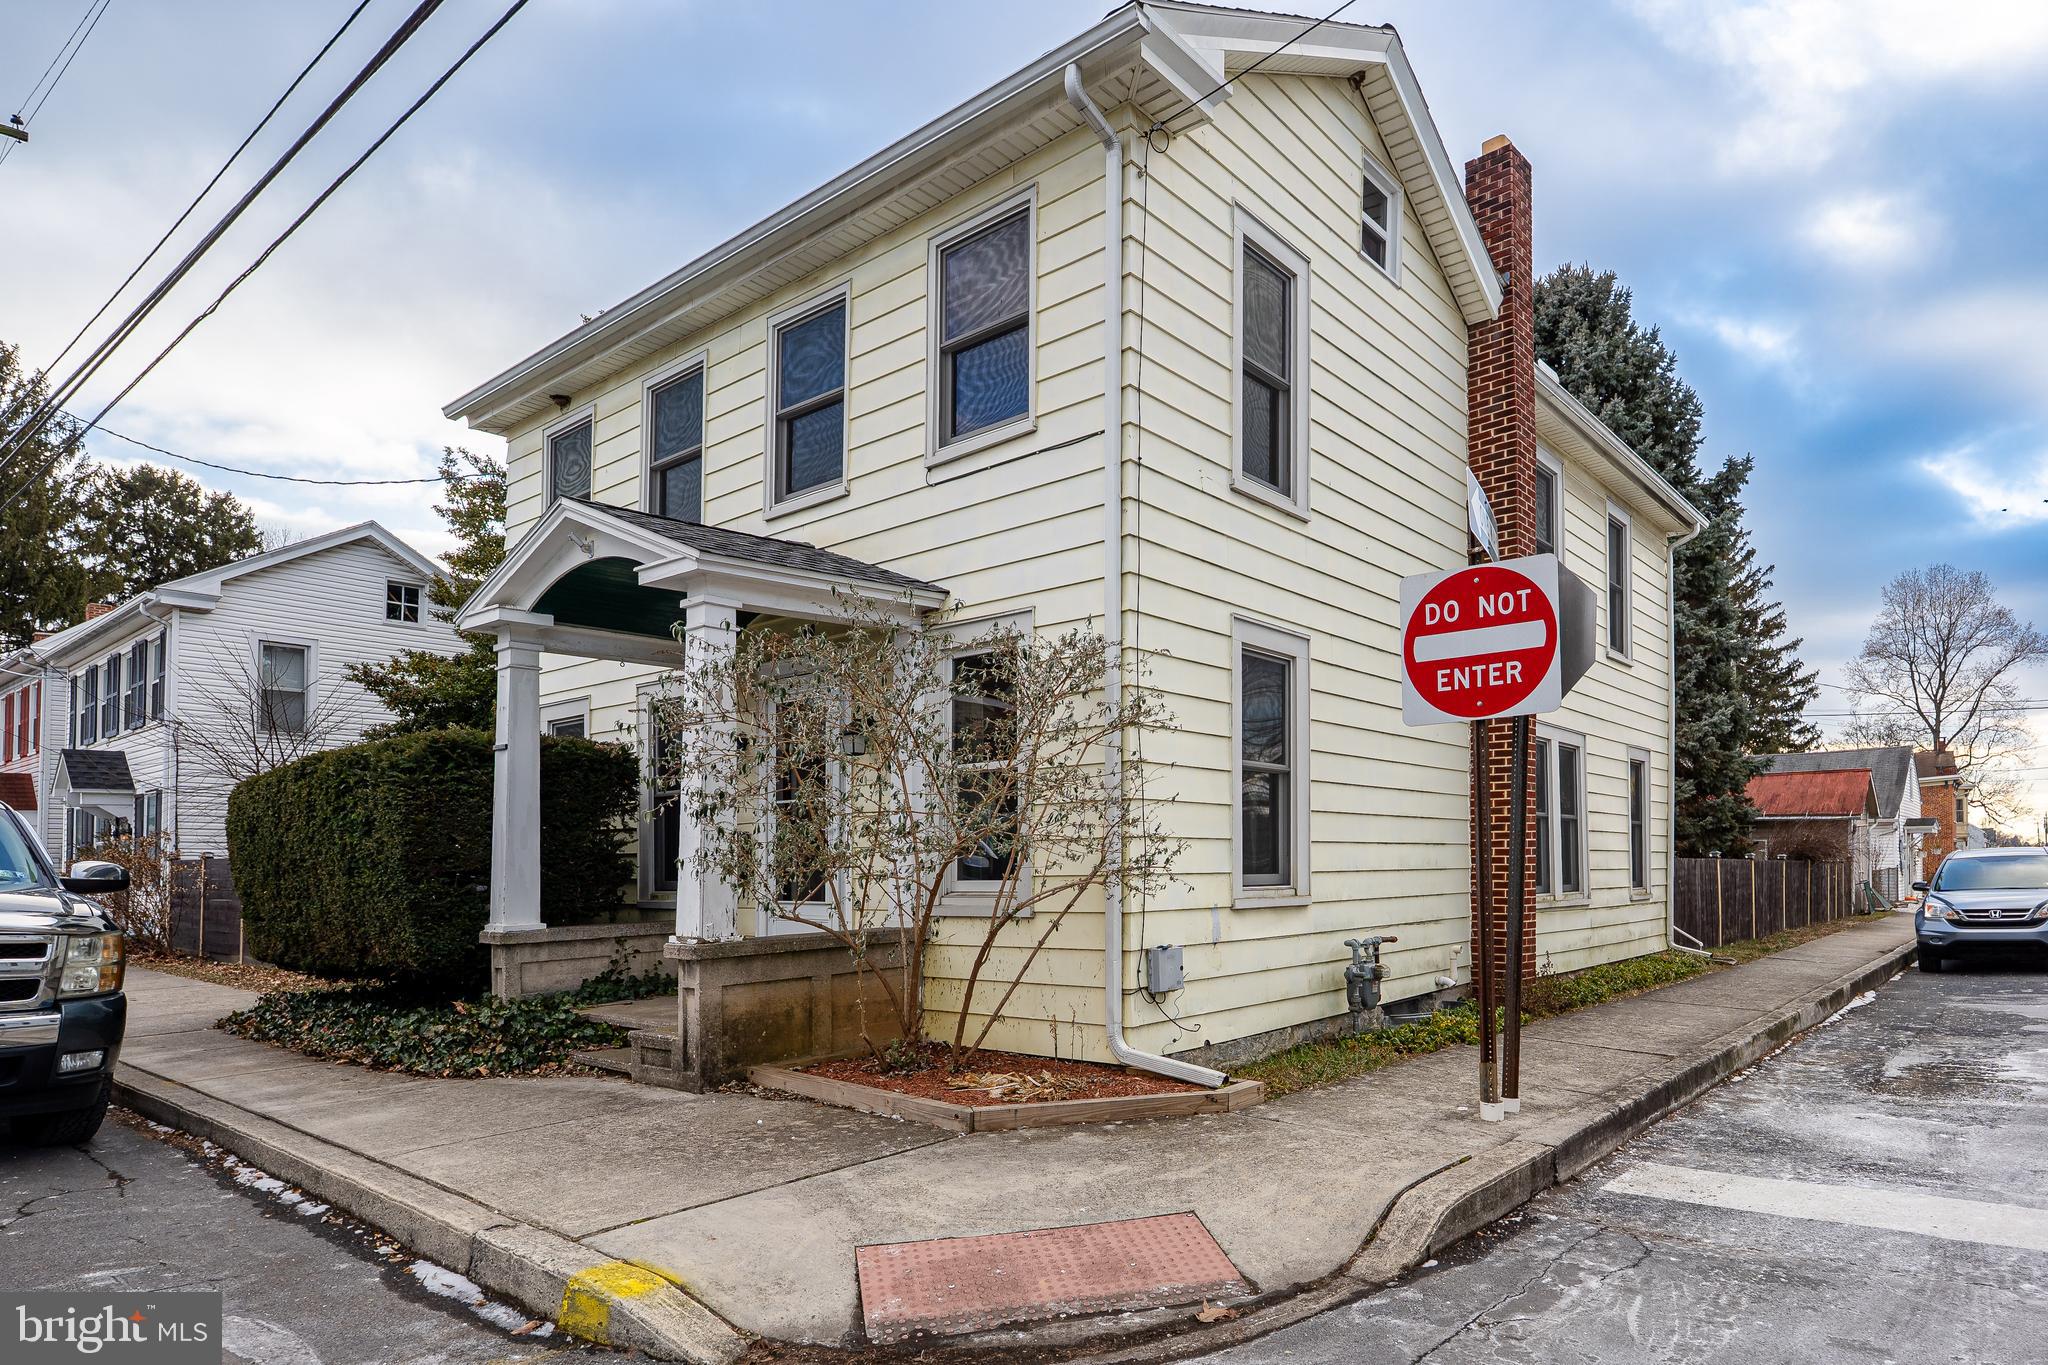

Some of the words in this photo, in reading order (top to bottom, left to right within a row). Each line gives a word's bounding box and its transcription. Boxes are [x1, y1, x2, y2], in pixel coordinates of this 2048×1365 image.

[1425, 600, 1460, 626] DO
[1478, 588, 1532, 618] NOT
[1437, 660, 1523, 692] ENTER
